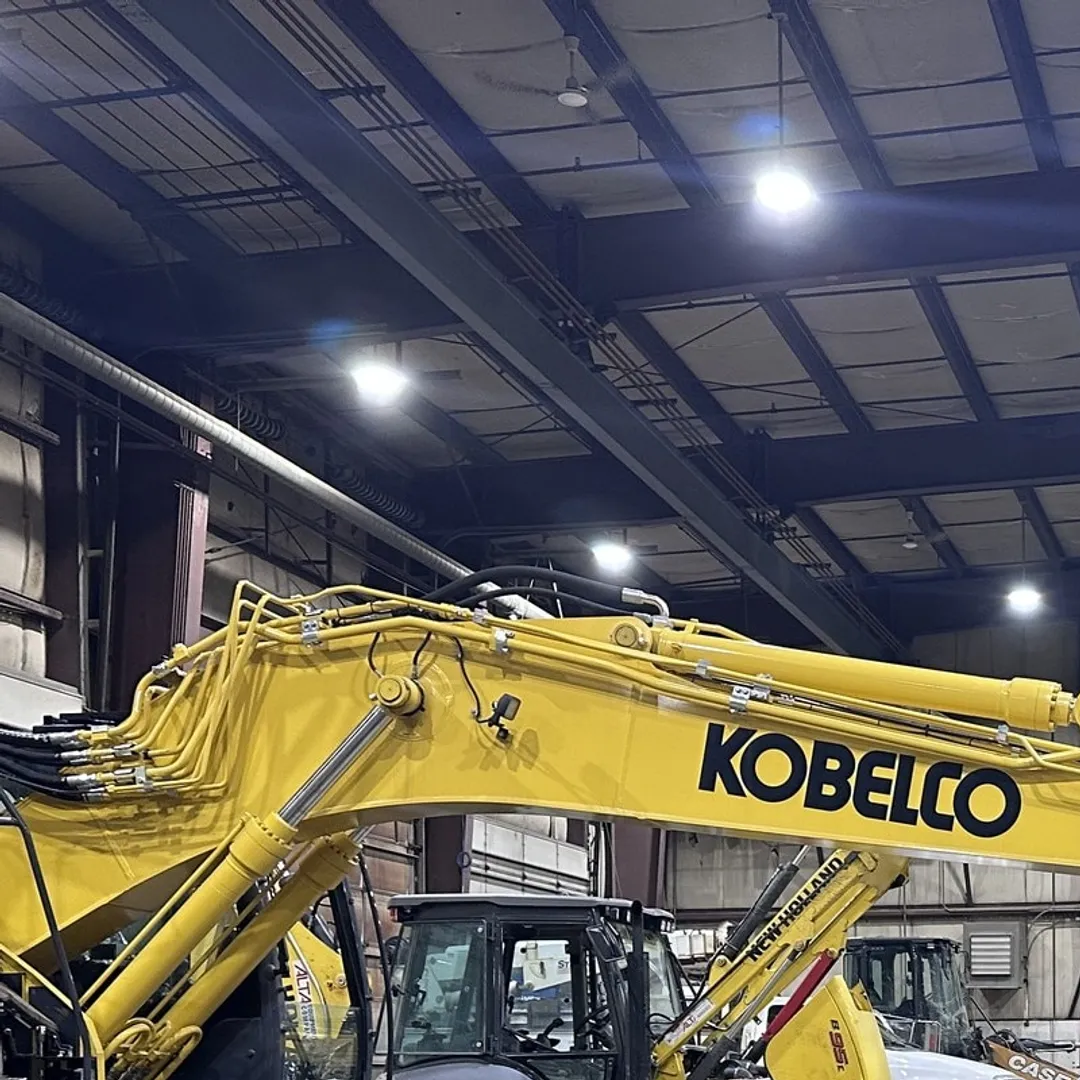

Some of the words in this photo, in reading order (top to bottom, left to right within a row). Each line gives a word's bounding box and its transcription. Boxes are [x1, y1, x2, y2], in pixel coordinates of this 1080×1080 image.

[698, 722, 1022, 838] KOBELCO
[745, 919, 783, 962] NEW
[778, 857, 845, 928] HOLLAND
[294, 964, 312, 1004] ALTA
